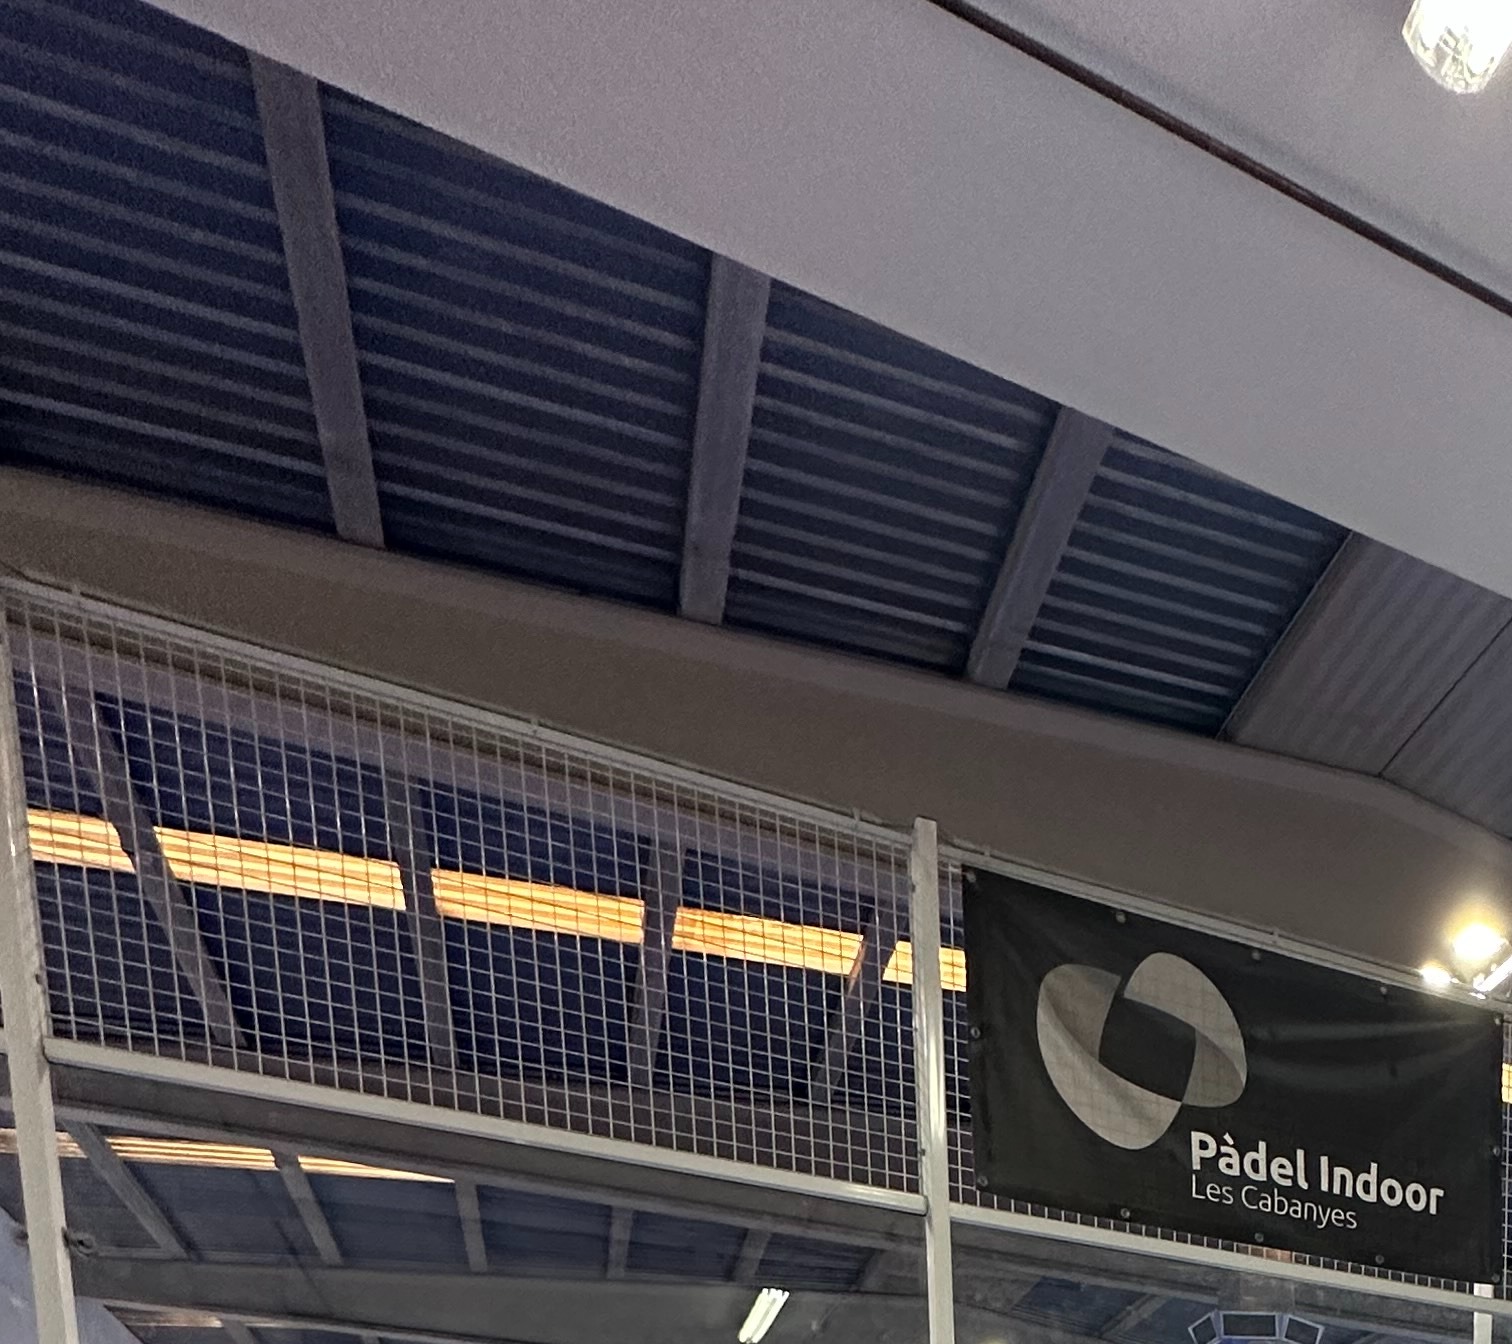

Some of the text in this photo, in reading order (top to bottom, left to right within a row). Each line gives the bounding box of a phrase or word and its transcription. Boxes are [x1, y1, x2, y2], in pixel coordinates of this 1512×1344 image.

[1190, 1130, 1444, 1215] Pàdel Indoor
[1191, 1174, 1358, 1229] Les Cabanyes
